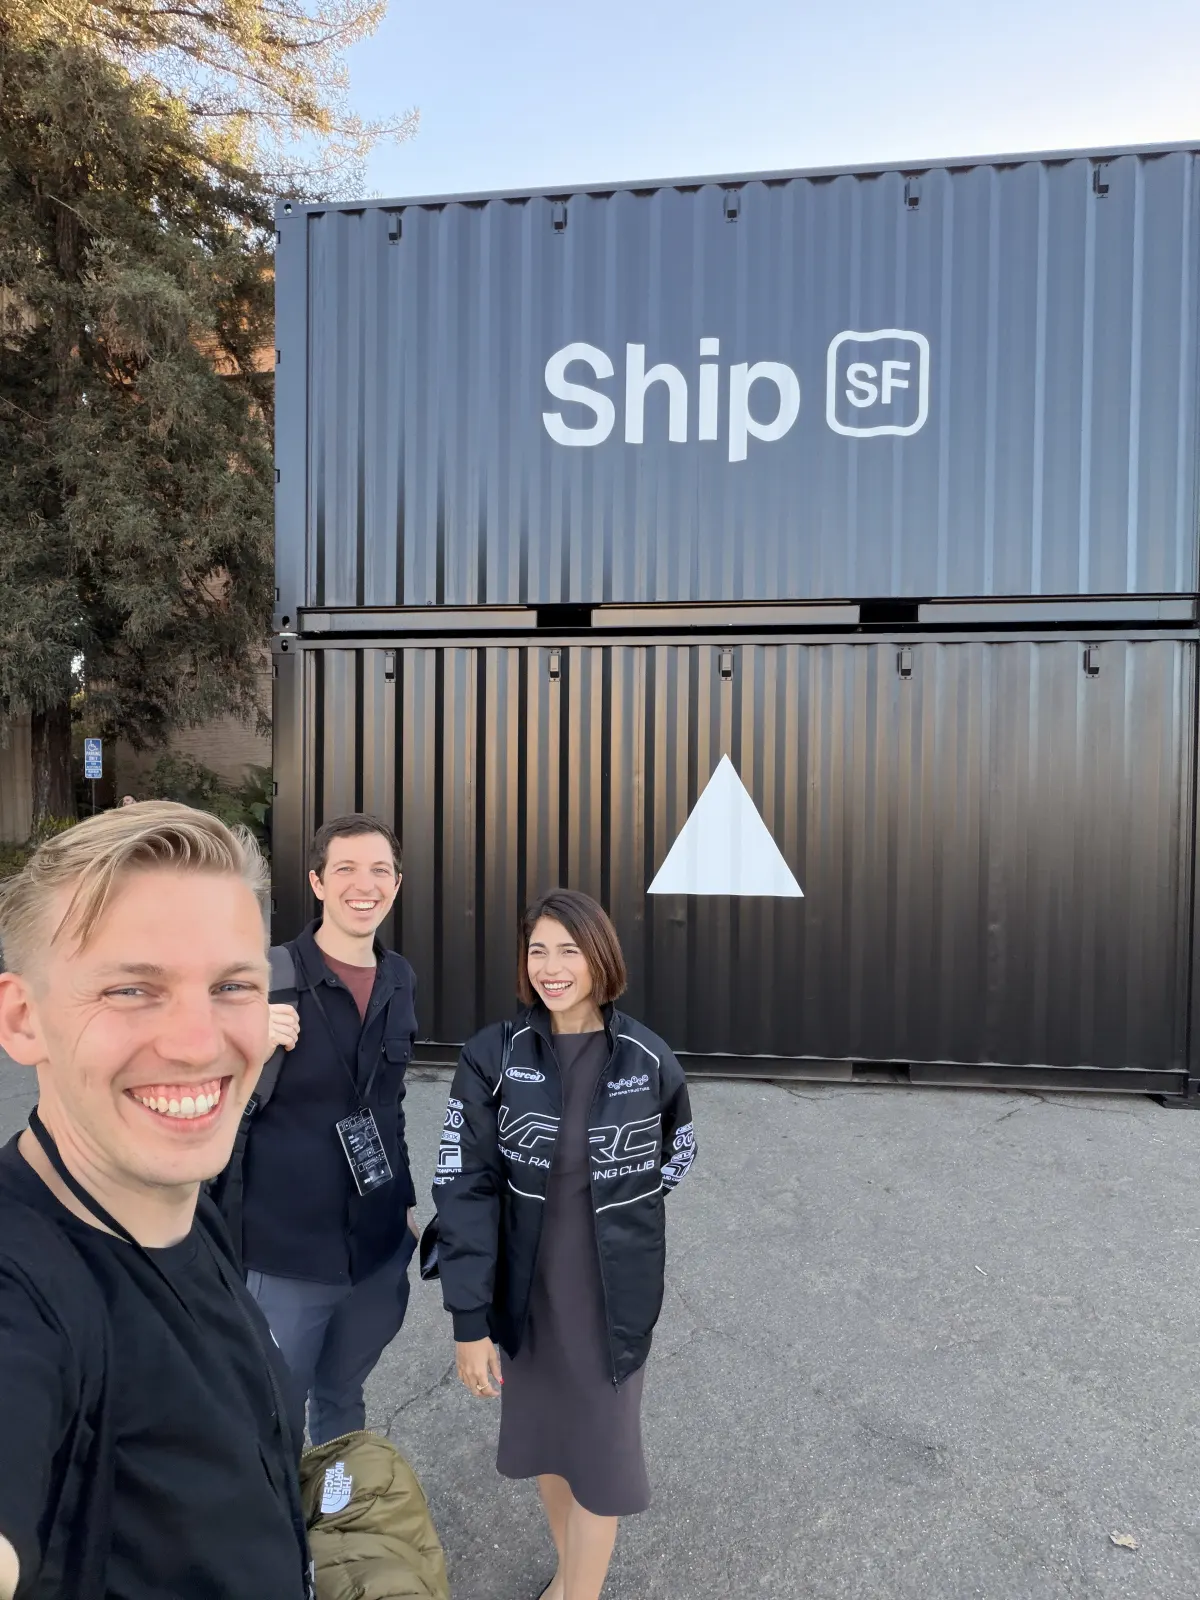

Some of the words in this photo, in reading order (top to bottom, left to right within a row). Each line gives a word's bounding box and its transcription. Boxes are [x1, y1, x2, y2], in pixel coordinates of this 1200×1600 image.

[542, 337, 800, 463] Ship
[845, 359, 911, 408] SF
[509, 1069, 541, 1081] Vercel
[619, 1160, 655, 1176] CLUB
[324, 1468, 335, 1494] FACE
[333, 1462, 344, 1495] NORTH
[341, 1475, 352, 1495] THE
